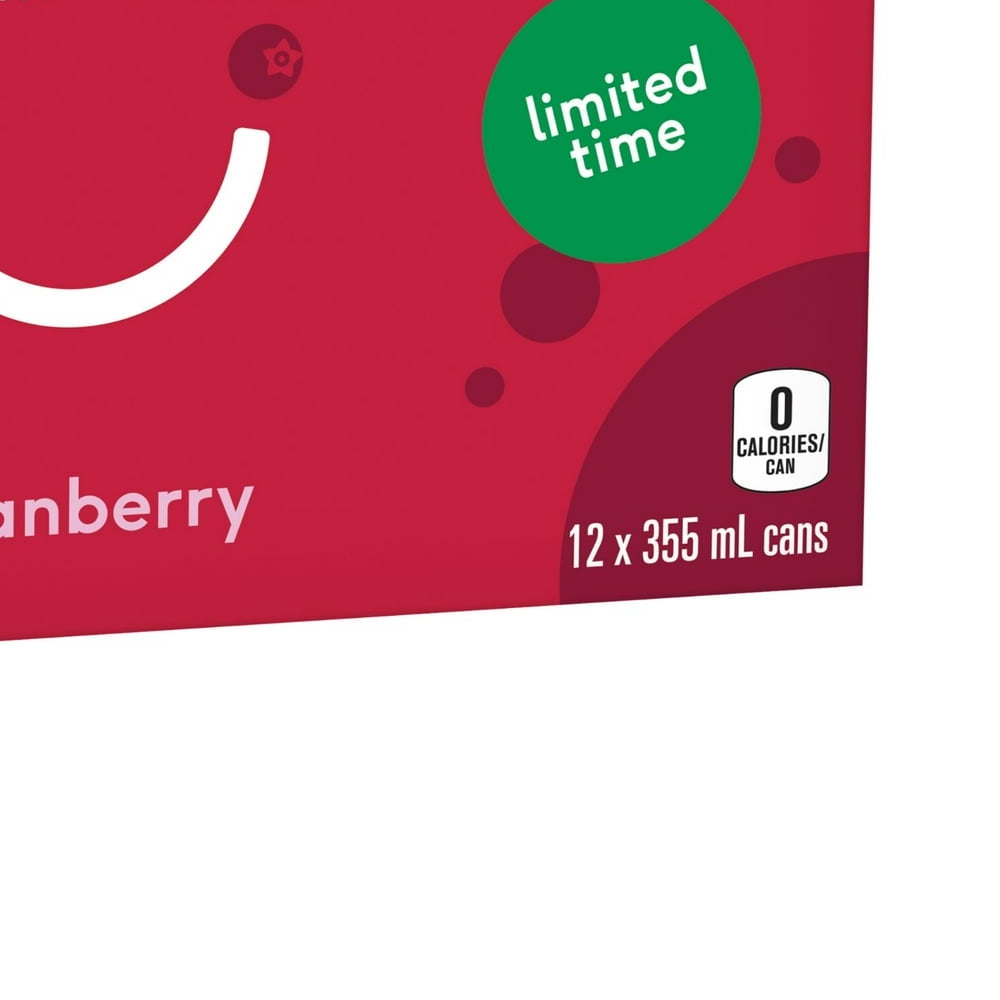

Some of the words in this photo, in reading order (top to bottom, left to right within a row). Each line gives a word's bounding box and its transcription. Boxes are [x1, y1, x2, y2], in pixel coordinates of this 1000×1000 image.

[525, 44, 707, 141] limited
[569, 119, 686, 179] time
[770, 386, 793, 431] 0
[736, 433, 825, 457] CALORIES/
[765, 458, 795, 475] CAN
[568, 522, 605, 569] 12
[614, 533, 632, 566] x
[642, 516, 700, 565] 355
[710, 513, 754, 560] mL
[763, 521, 829, 557] cans
